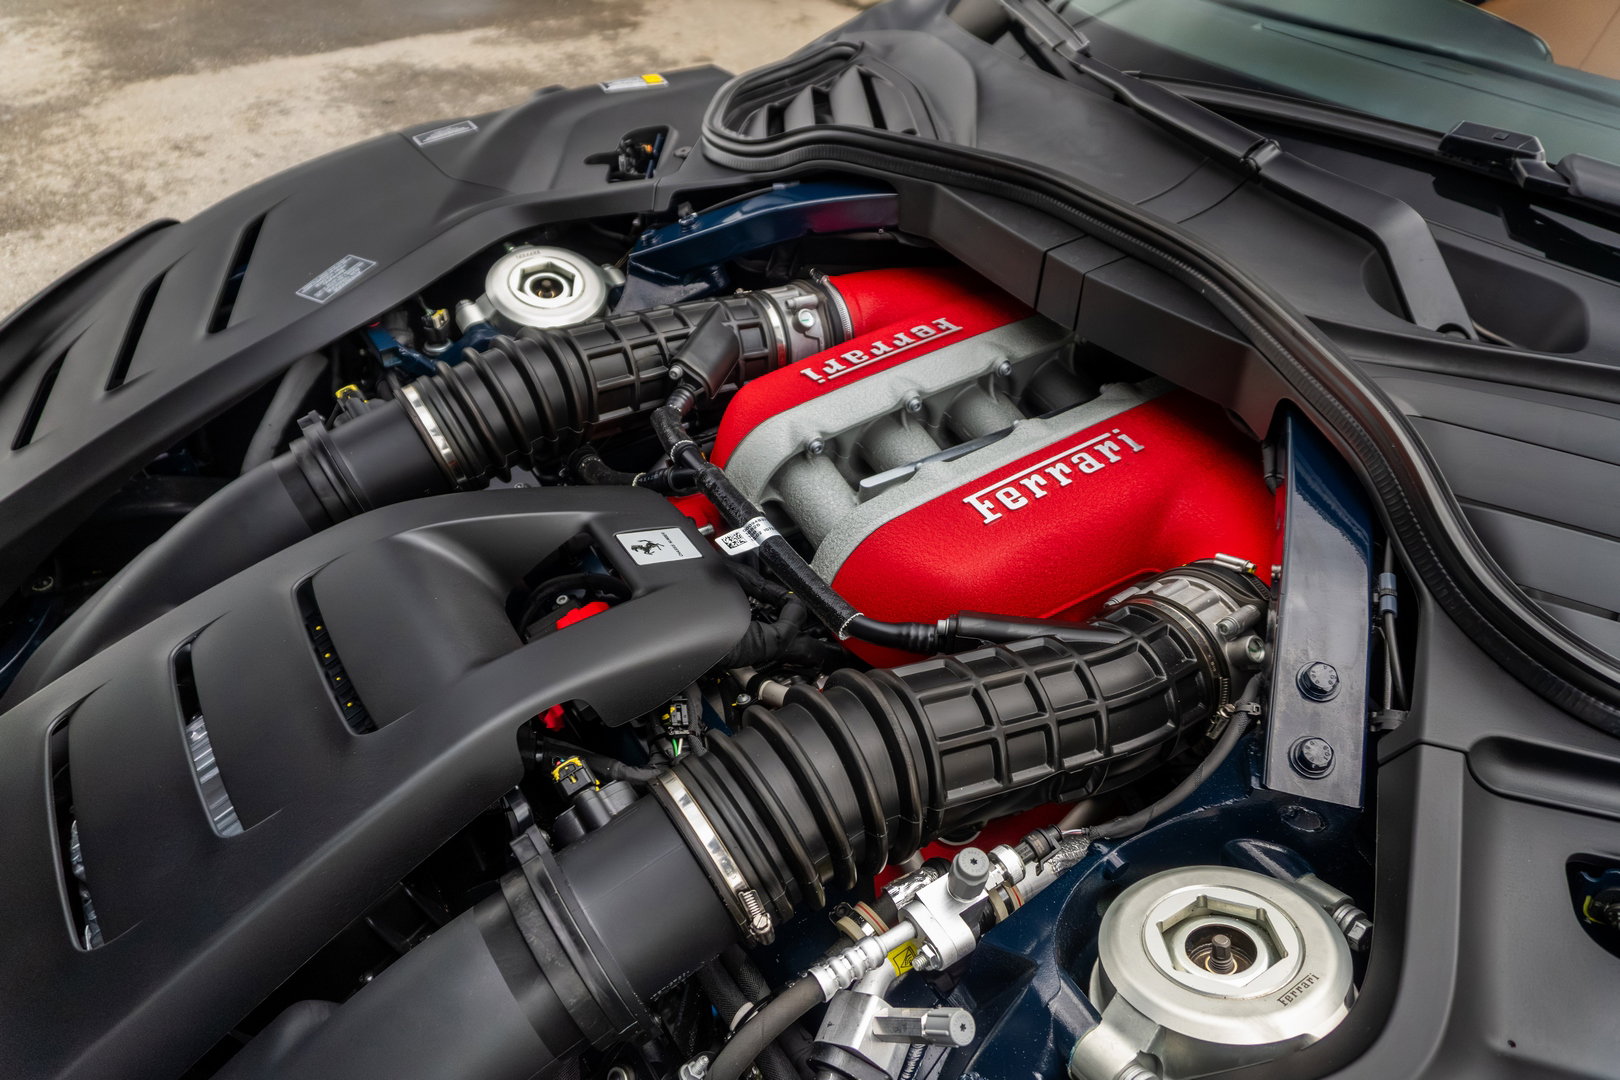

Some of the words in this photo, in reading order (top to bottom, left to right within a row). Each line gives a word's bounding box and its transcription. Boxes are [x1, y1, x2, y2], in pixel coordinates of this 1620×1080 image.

[800, 318, 963, 384] Ferrari
[963, 429, 1145, 524] Ferrari
[1277, 973, 1320, 1007] Ferrari
